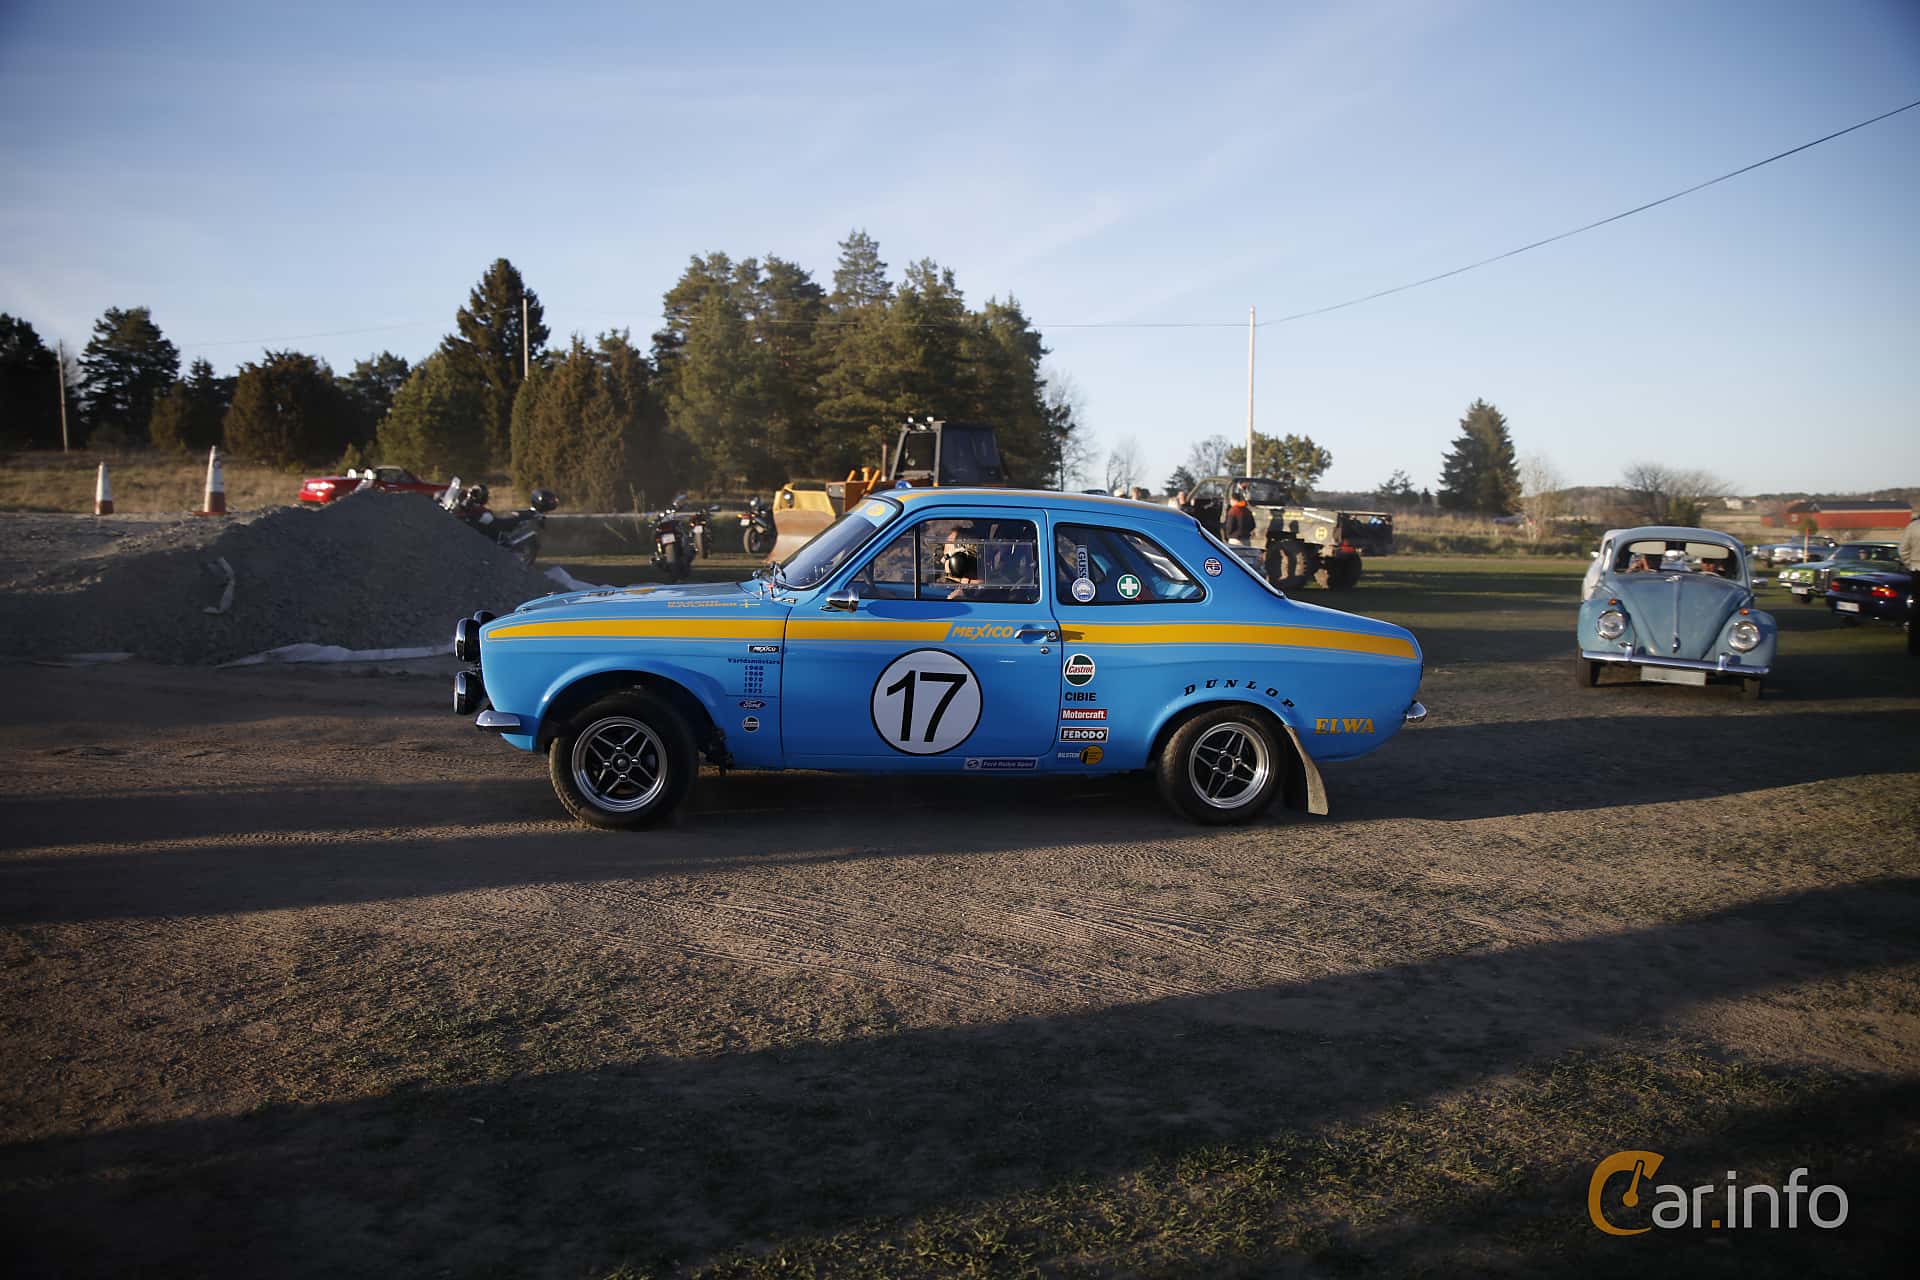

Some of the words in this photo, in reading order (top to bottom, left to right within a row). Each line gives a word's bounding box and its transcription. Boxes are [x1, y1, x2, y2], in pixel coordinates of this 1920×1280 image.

[952, 624, 1014, 641] MEXICO
[1069, 665, 1094, 675] Castrol
[1064, 691, 1097, 702] CIBIE
[1183, 679, 1295, 709] DUNLOP
[886, 670, 968, 743] 17
[1062, 730, 1105, 740] FERODO
[1313, 718, 1375, 735] ELWA
